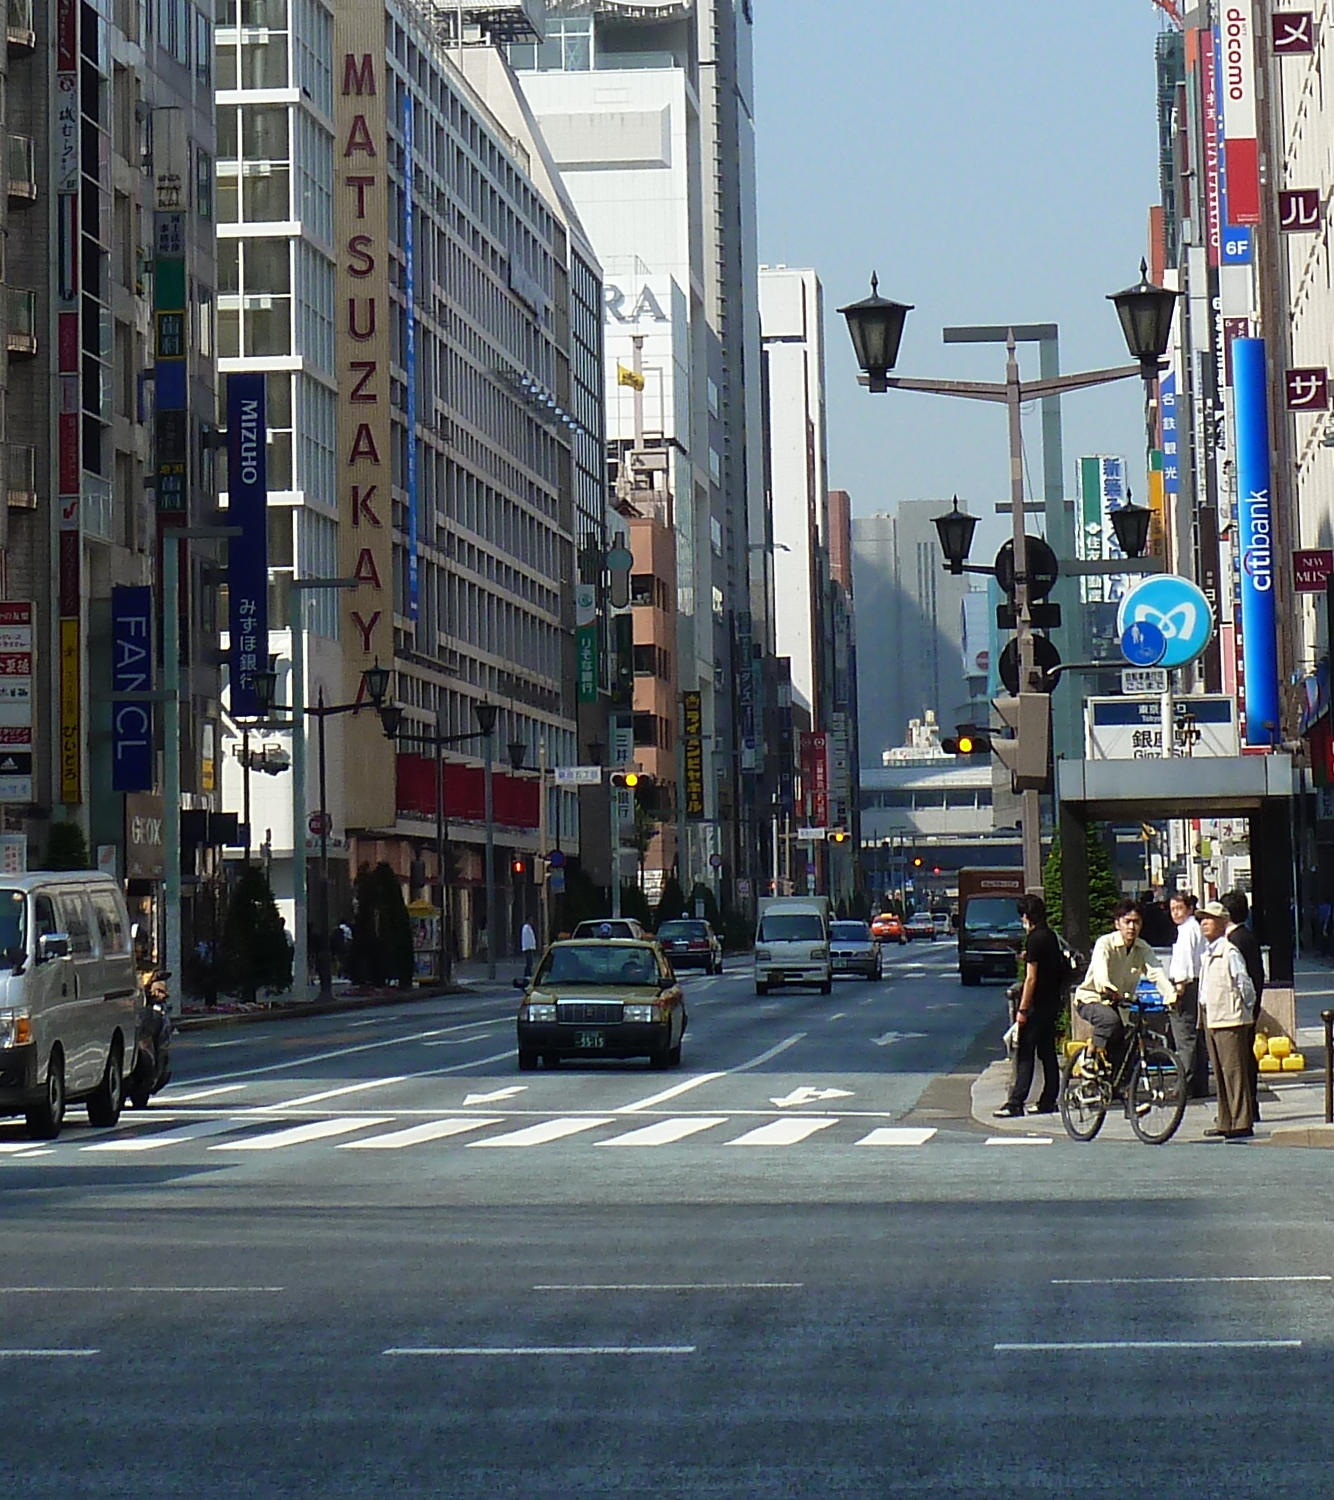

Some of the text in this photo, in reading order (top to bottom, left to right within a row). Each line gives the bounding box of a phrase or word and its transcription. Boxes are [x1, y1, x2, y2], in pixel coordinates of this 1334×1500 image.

[1226, 7, 1244, 100] docomo
[1225, 240, 1249, 256] 6F
[240, 399, 258, 485] MIZUHO
[1162, 392, 1178, 481] 名鉄観光
[1243, 489, 1271, 592] citibank
[115, 614, 150, 760] FANCL
[239, 598, 257, 690] みずほ銀行
[580, 637, 595, 694] りそな銀行
[131, 816, 162, 846] GEOX
